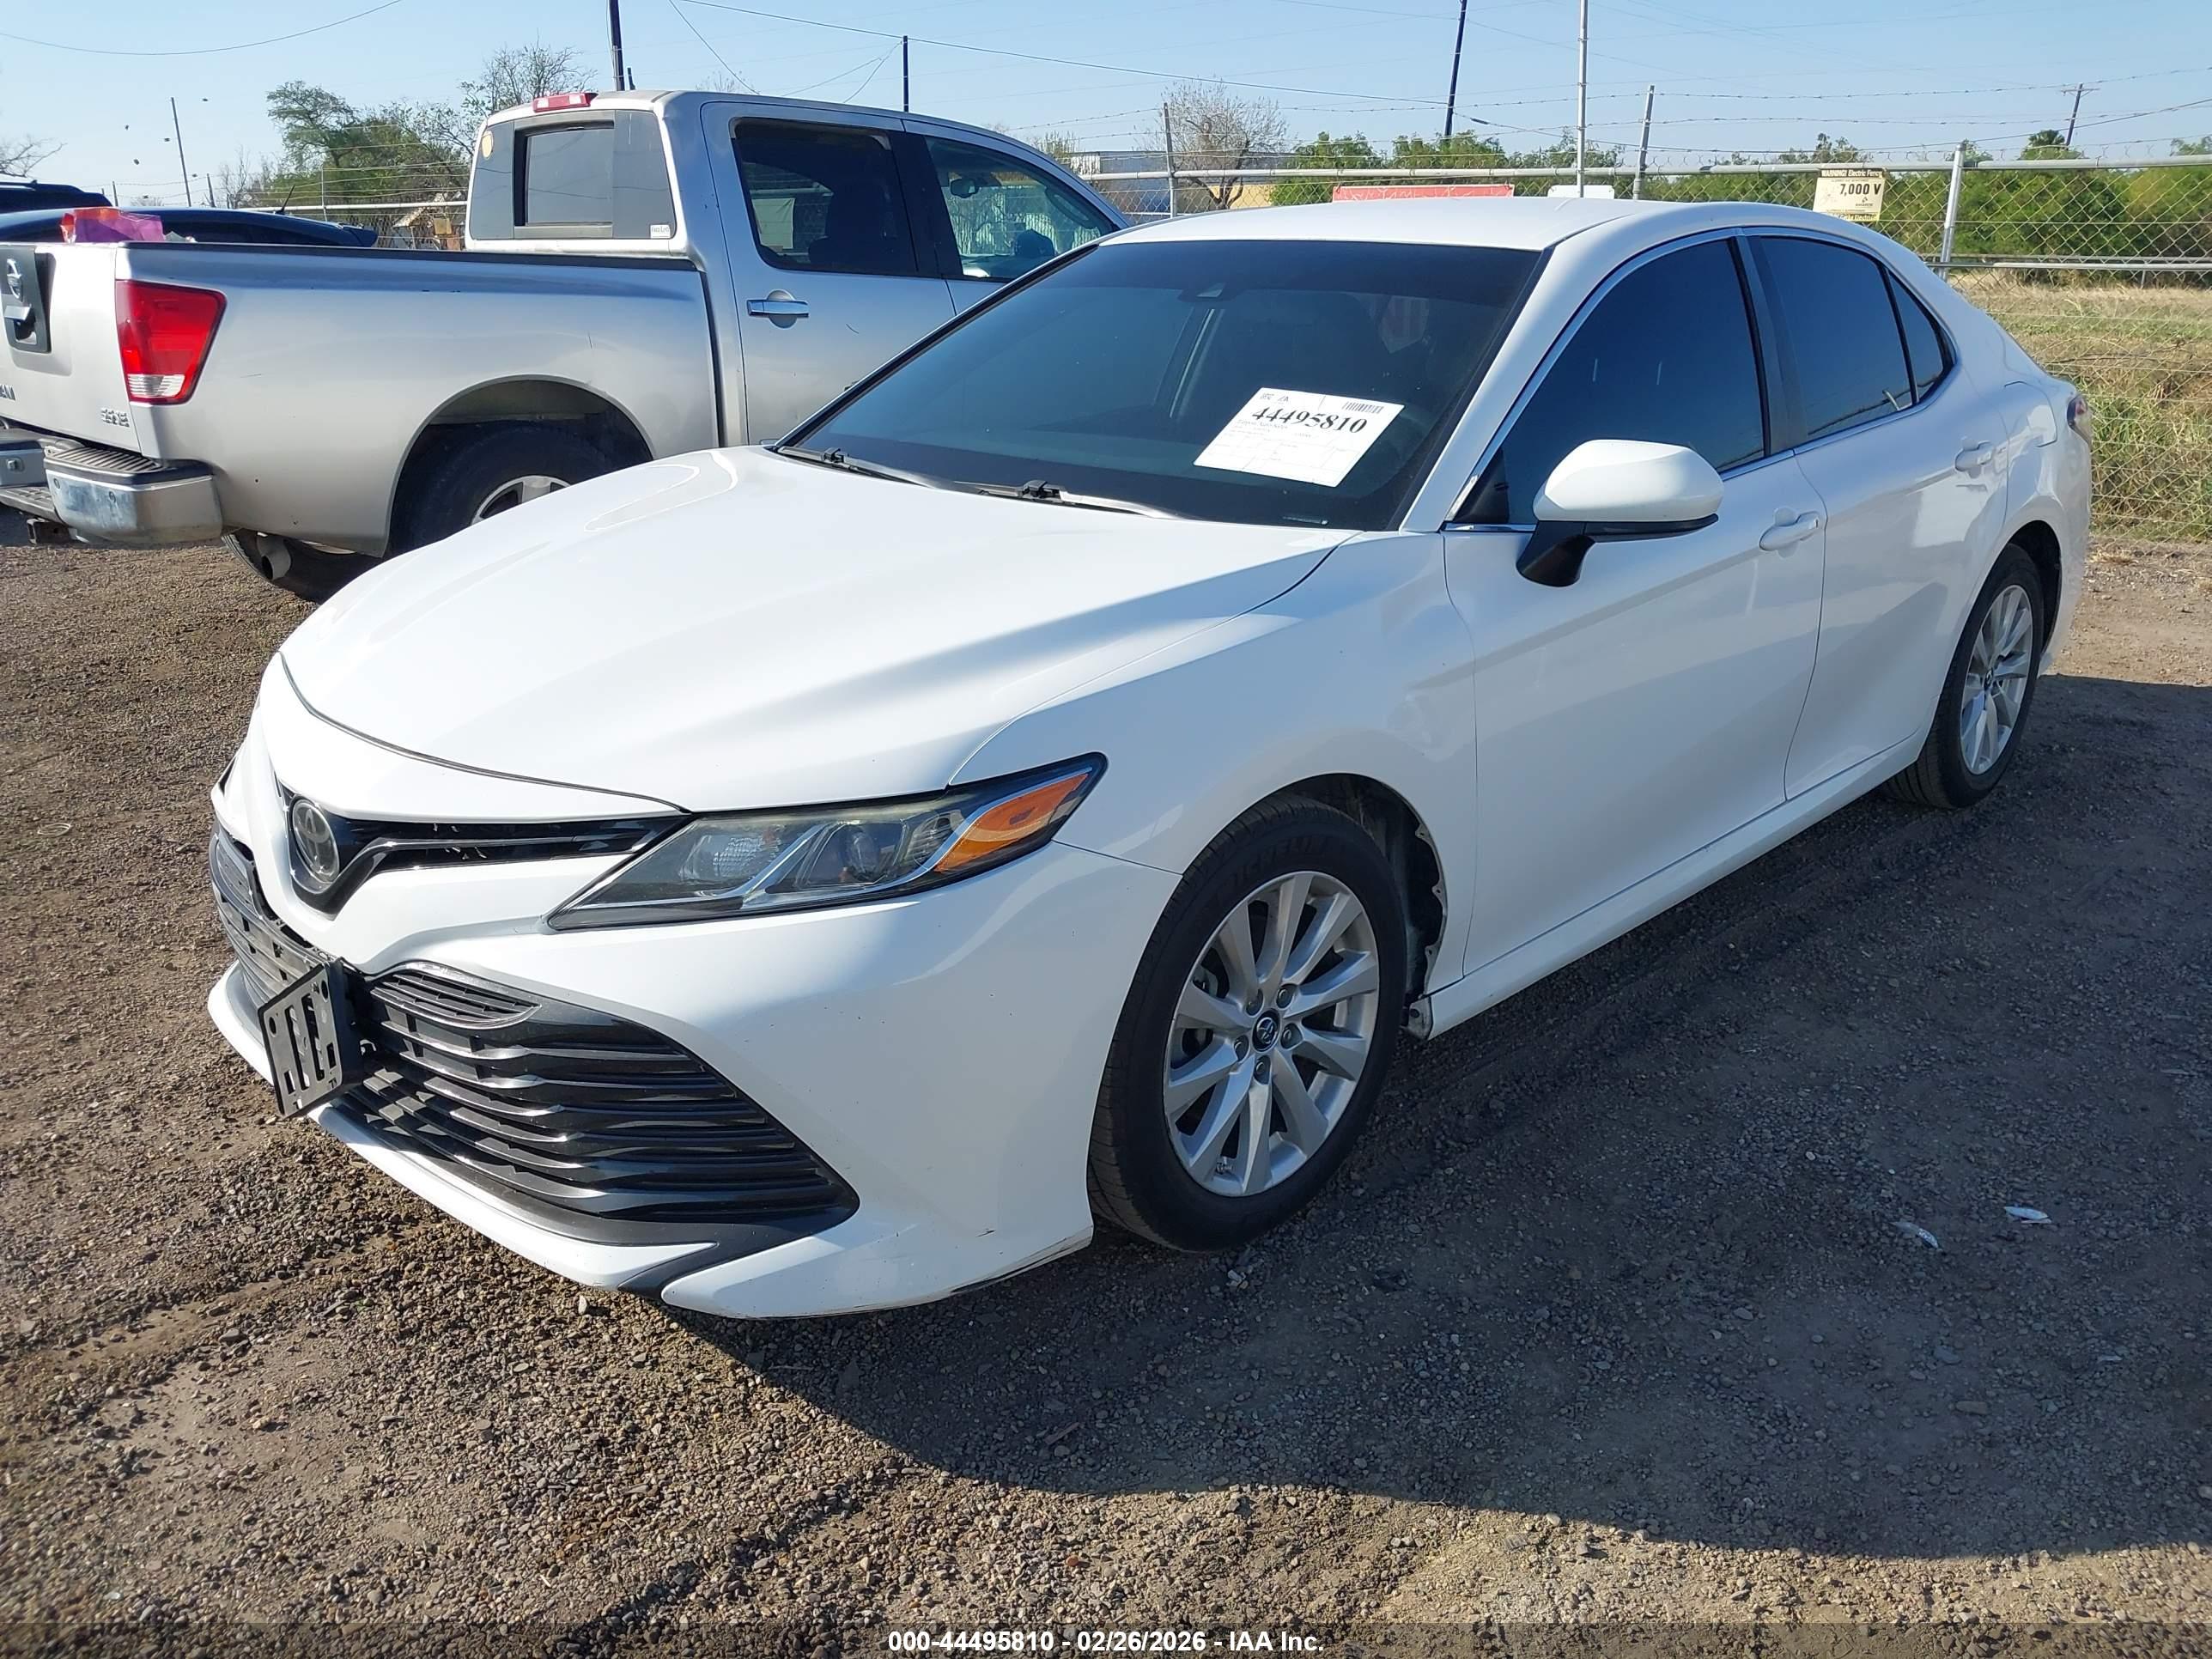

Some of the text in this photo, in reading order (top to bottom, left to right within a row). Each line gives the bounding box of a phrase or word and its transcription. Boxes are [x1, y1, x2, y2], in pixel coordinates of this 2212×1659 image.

[1840, 183, 1881, 197] 7,000 V
[1252, 407, 1368, 433] 44495810
